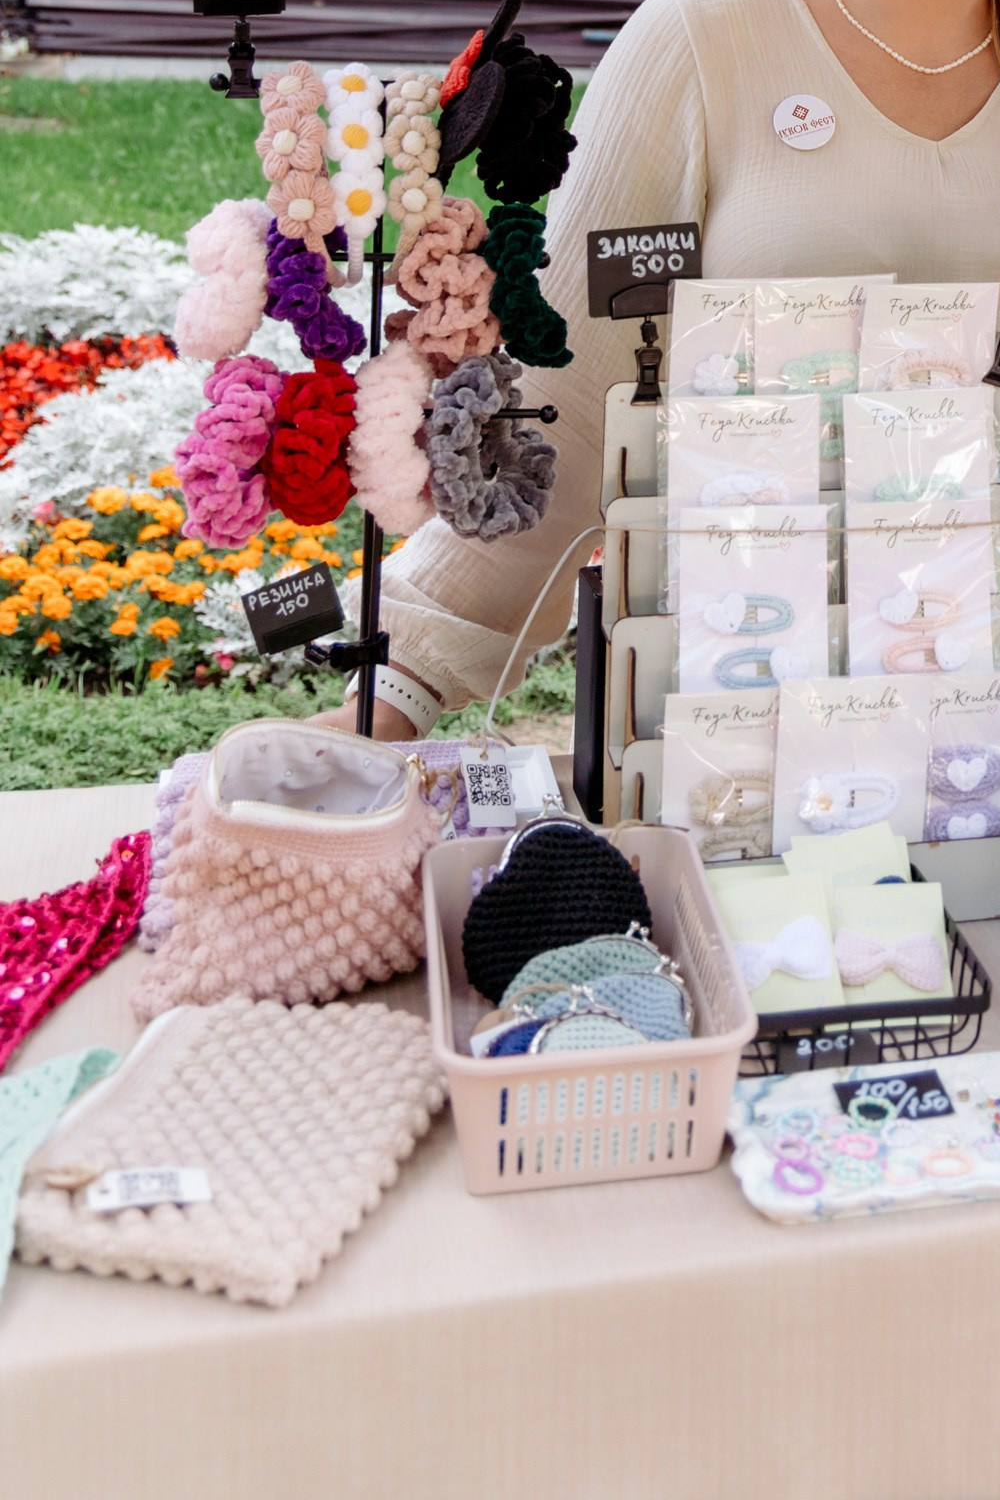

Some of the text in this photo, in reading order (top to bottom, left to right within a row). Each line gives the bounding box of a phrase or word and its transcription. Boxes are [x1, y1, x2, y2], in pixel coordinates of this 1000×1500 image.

[597, 231, 696, 259] ЗАКОЛКИ
[632, 253, 684, 278] 500
[781, 284, 867, 325] FeyaKruchk
[248, 572, 326, 611] РЕЗИНКА
[276, 593, 309, 616] 150
[797, 1035, 855, 1056] 200
